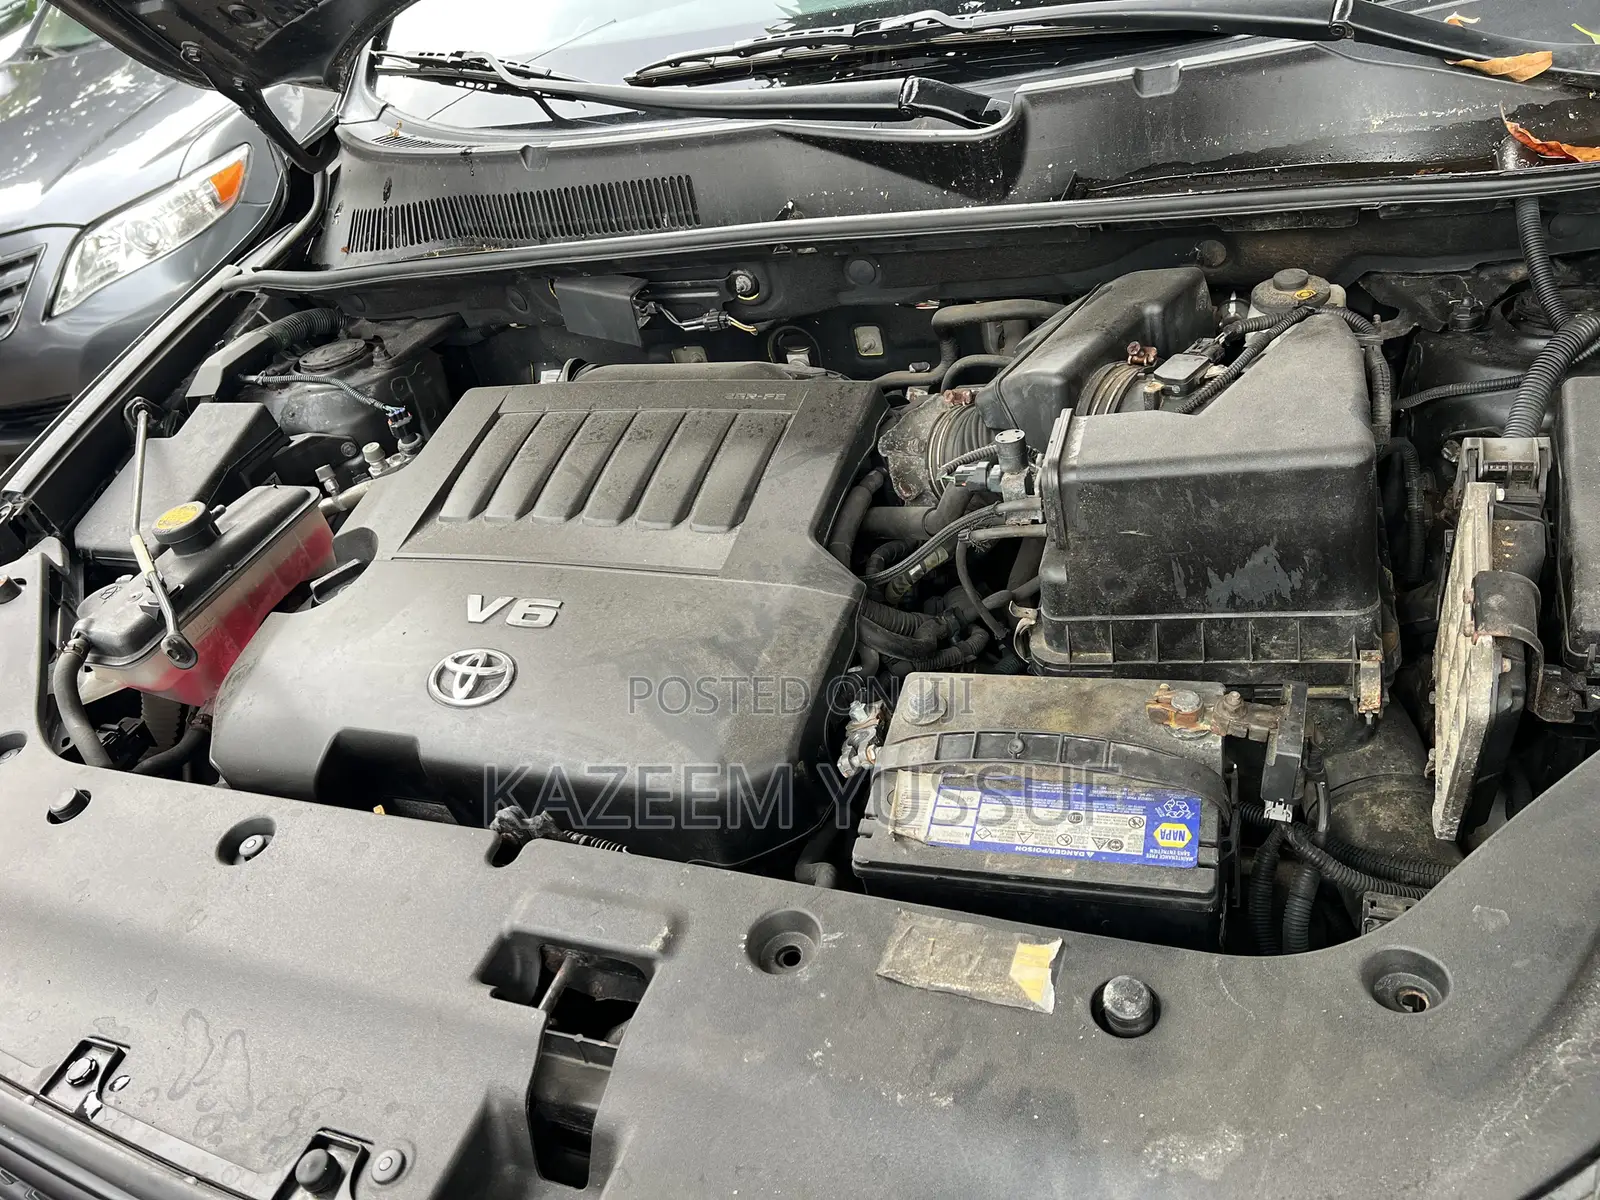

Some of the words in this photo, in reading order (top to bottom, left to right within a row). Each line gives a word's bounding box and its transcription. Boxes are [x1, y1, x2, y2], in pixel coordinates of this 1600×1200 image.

[467, 594, 563, 628] V6
[1159, 829, 1186, 842] NAPA
[1015, 844, 1086, 857] DANGER/POISON
